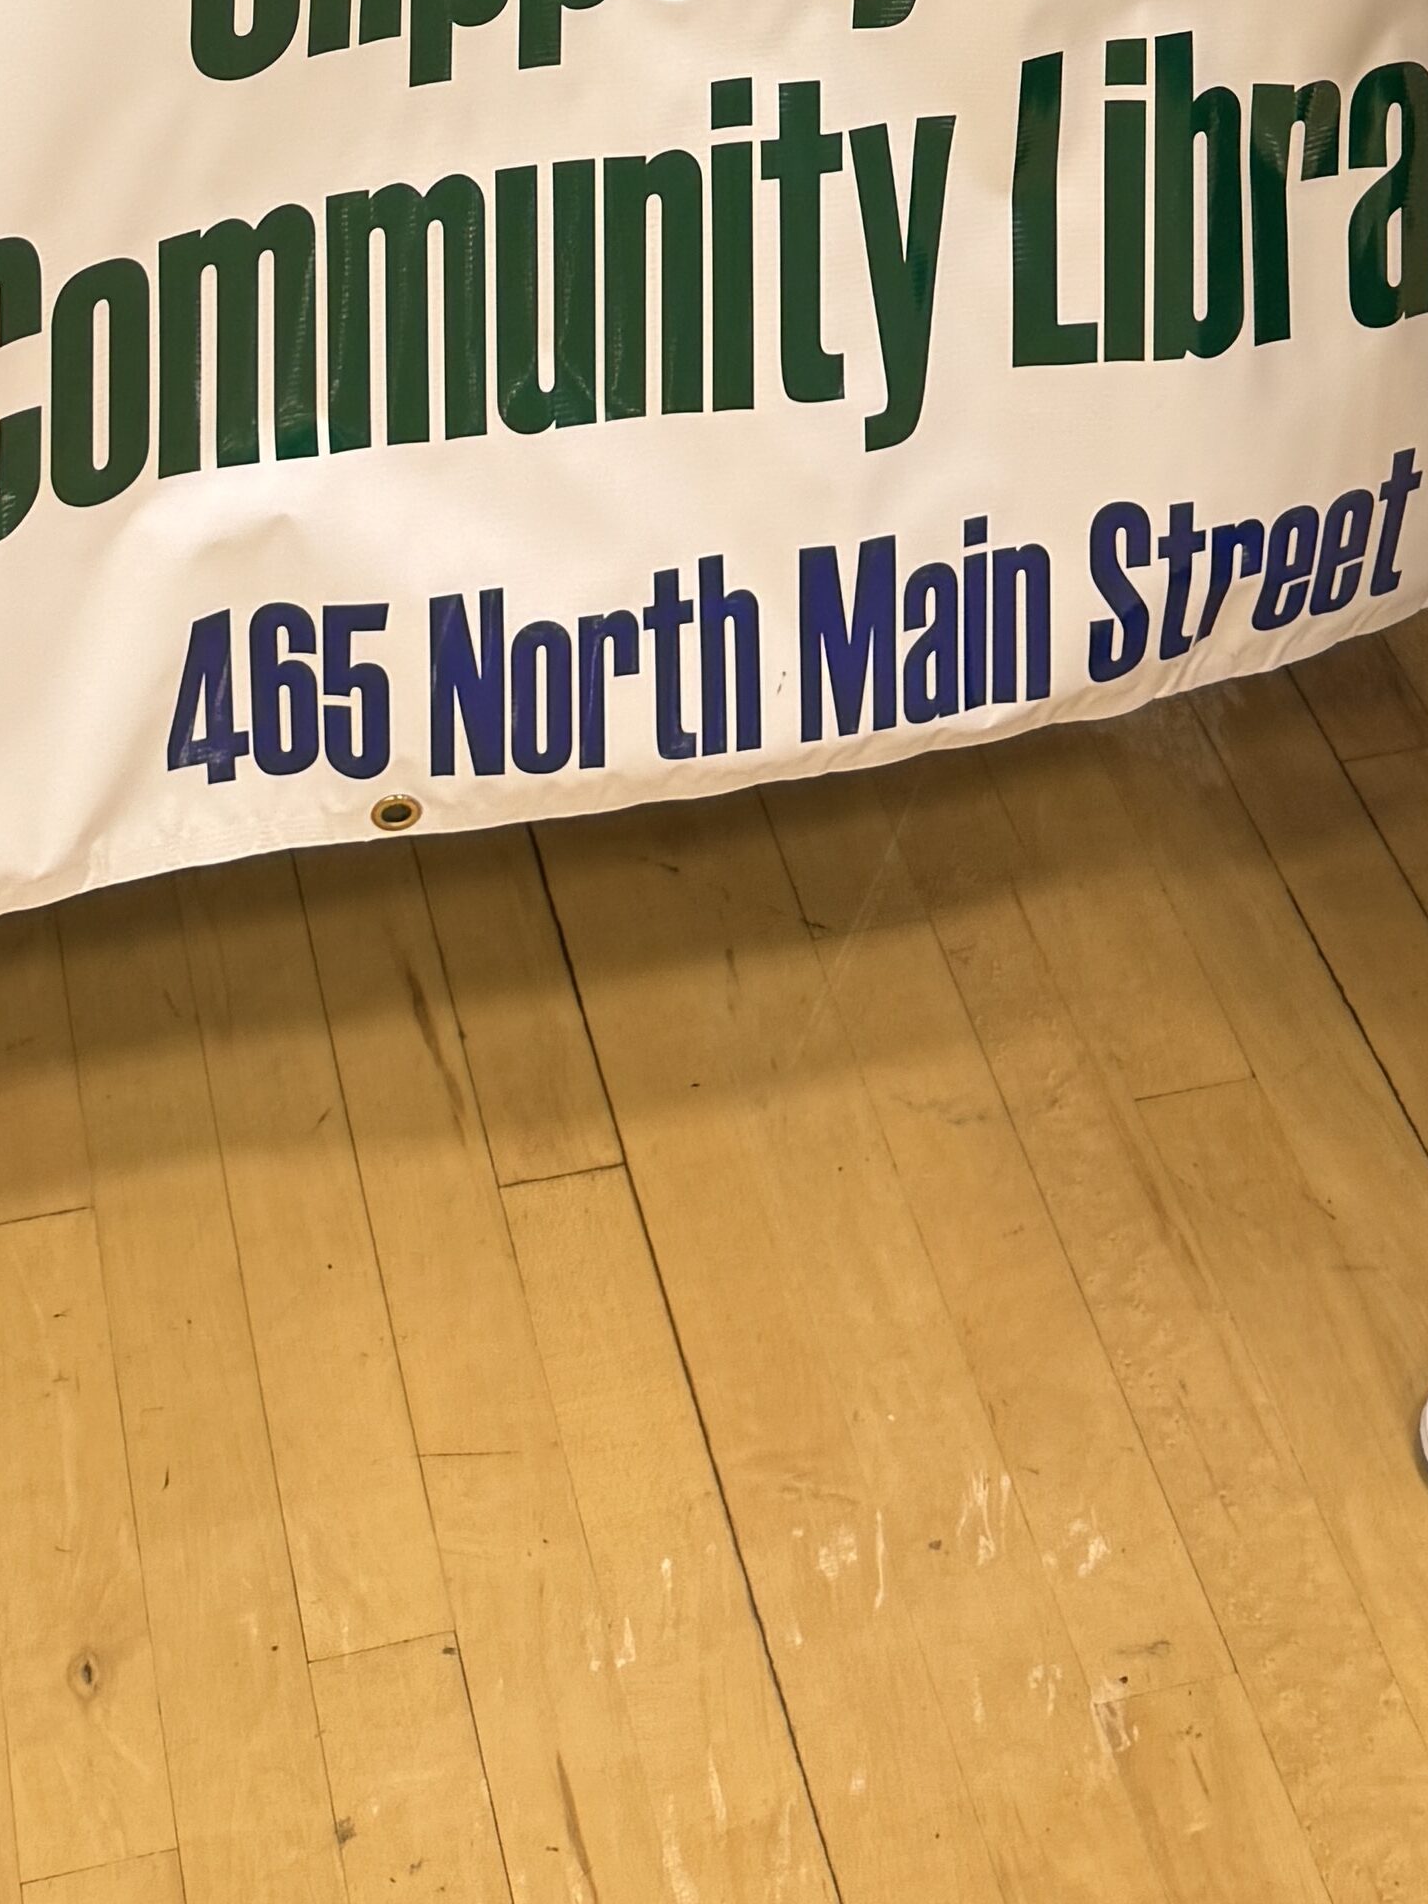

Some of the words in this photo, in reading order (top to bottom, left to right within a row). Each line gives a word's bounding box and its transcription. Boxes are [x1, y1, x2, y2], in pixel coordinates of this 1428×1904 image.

[166, 602, 391, 785] 465
[429, 554, 762, 777] North
[799, 513, 1051, 743] Main
[1088, 447, 1423, 683] Street
